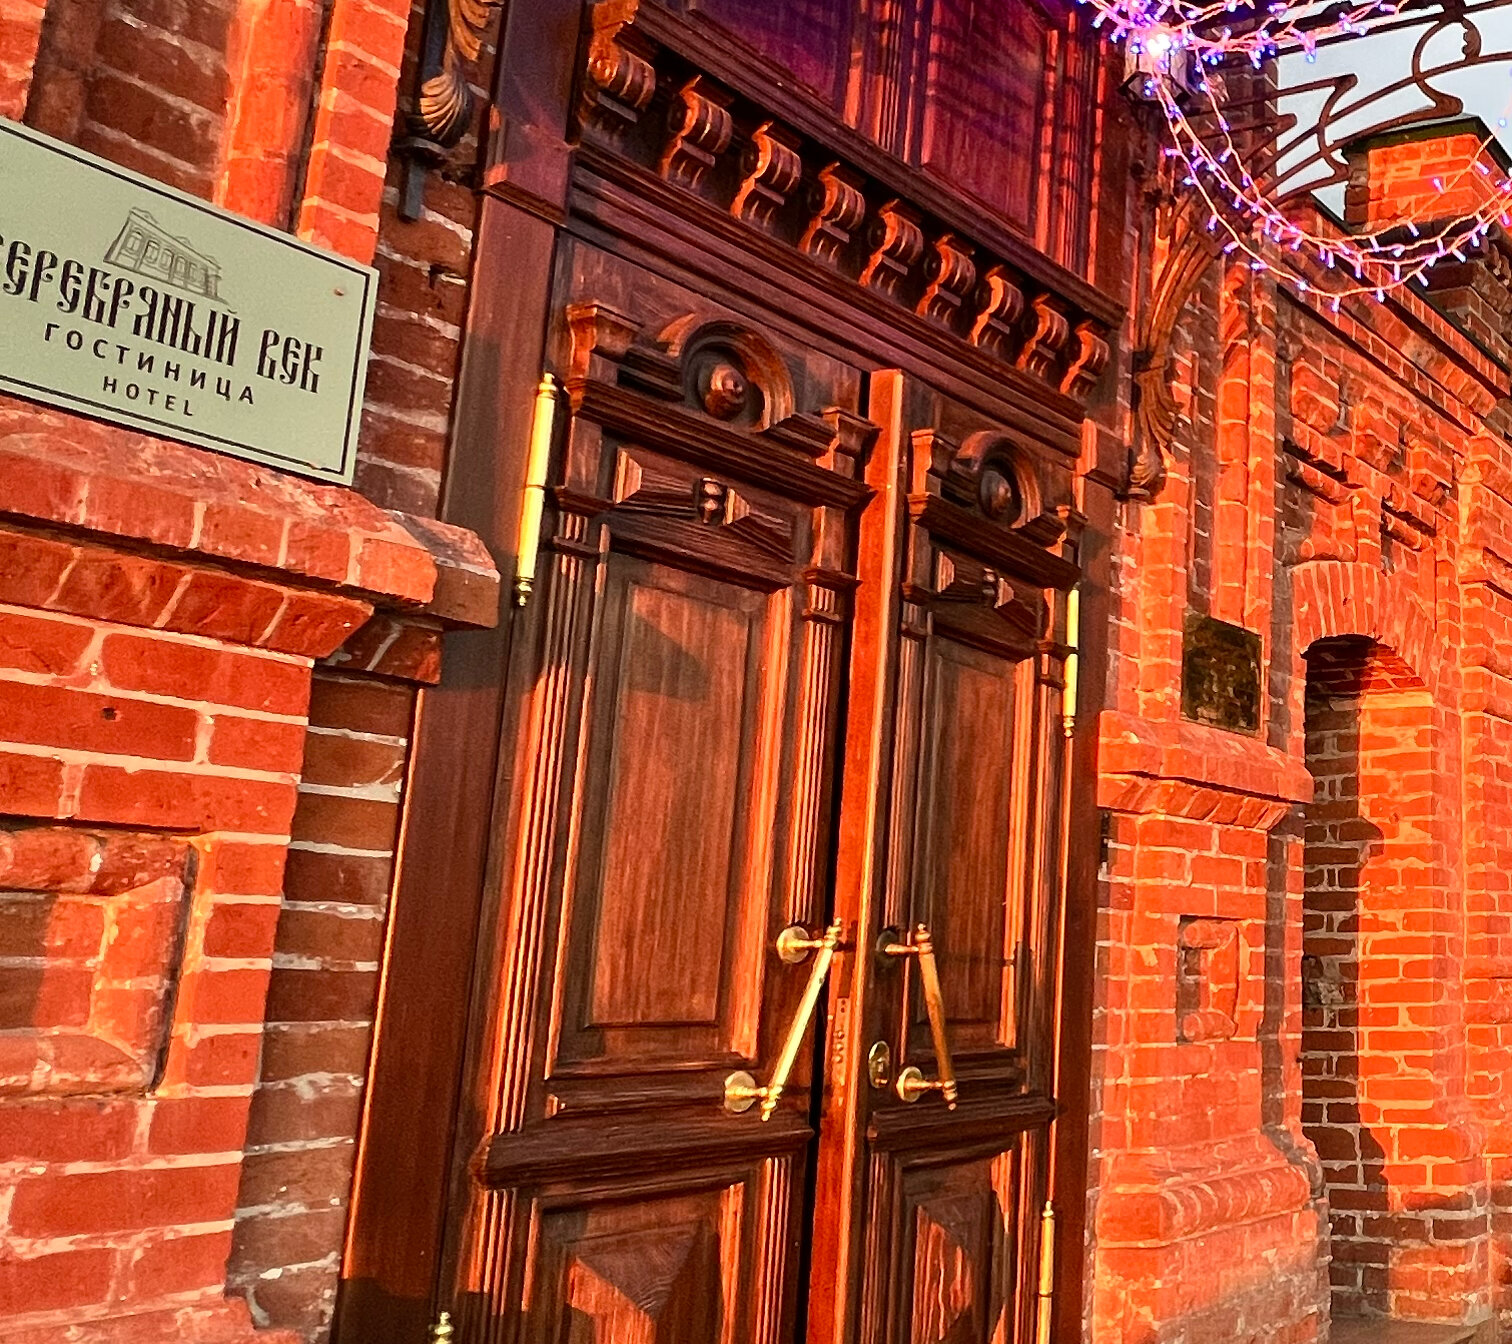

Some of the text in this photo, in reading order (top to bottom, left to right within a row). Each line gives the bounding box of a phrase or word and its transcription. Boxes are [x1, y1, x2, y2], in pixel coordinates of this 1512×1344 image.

[0, 234, 324, 393] ЕРЕБРЯНЫЙ ВЕК
[44, 323, 255, 405] ГОСТИНИЦА
[102, 376, 195, 416] HOTEL
